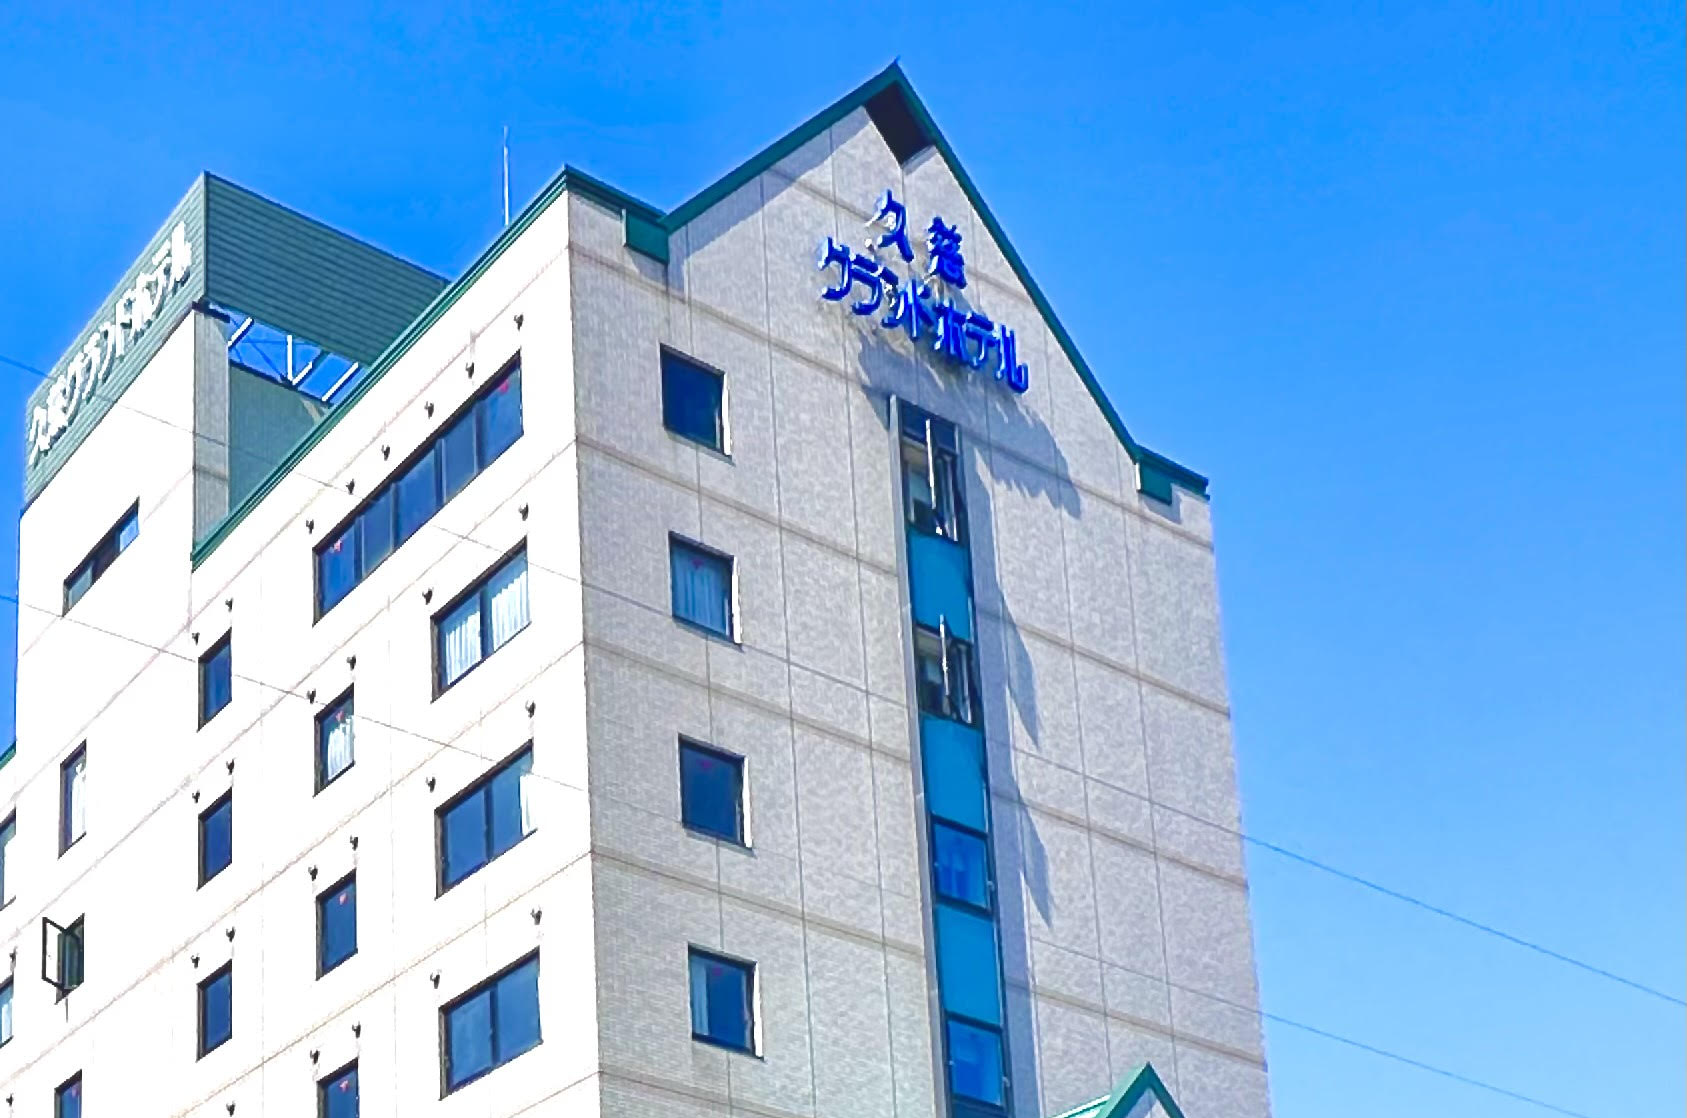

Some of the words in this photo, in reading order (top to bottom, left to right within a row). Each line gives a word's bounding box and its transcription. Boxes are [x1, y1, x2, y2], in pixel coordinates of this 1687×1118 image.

[818, 236, 1029, 393] グランドホテル
